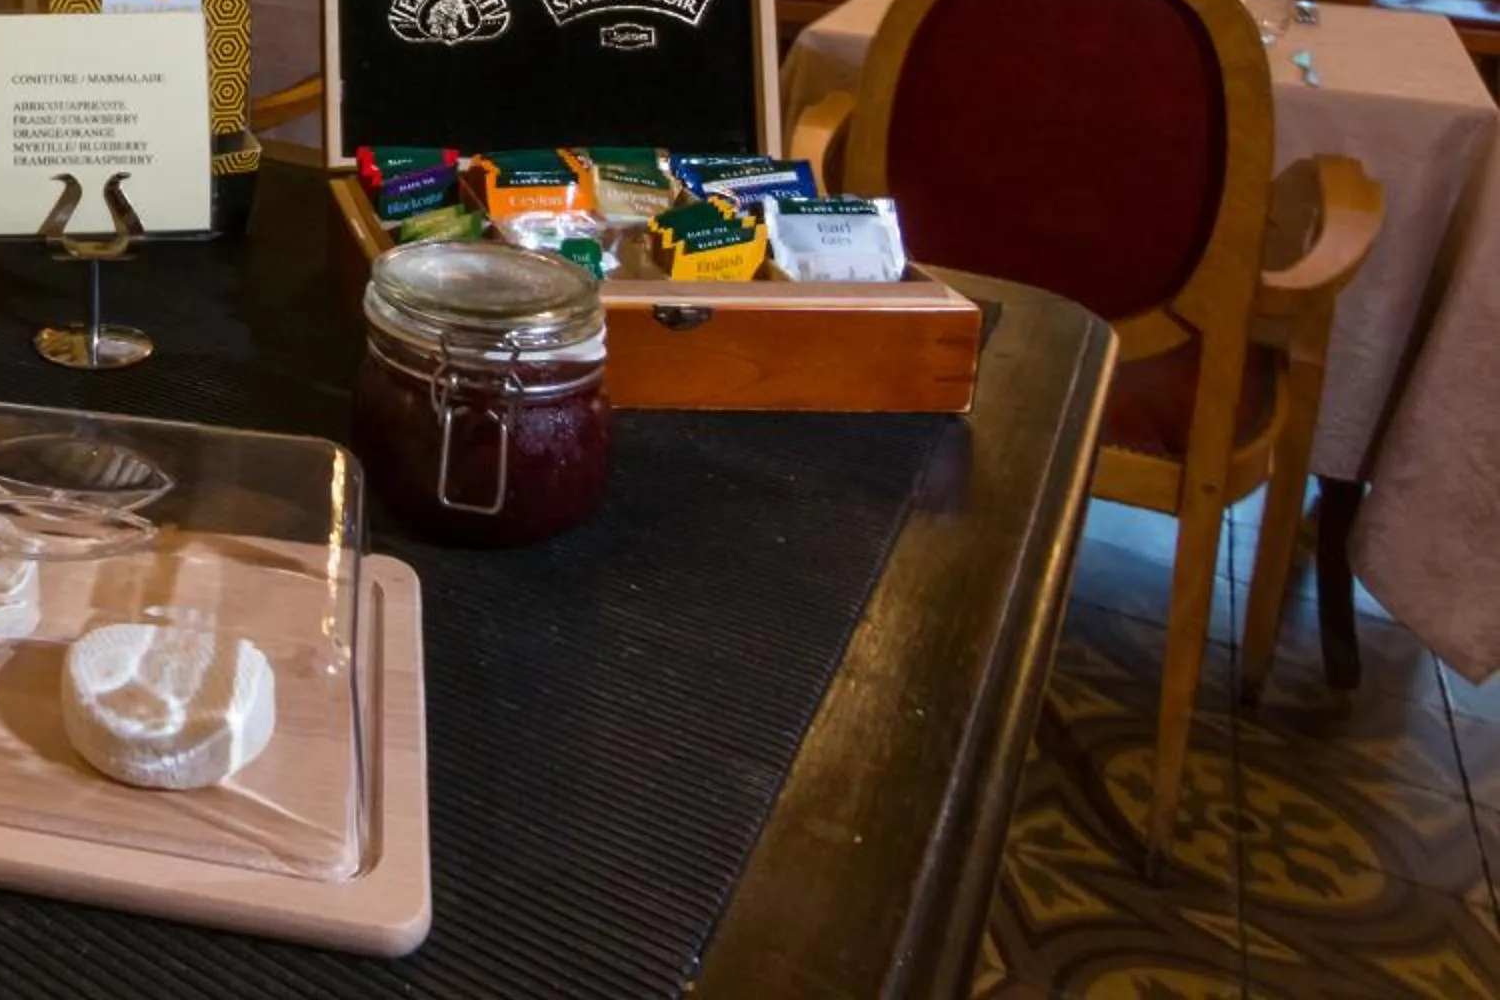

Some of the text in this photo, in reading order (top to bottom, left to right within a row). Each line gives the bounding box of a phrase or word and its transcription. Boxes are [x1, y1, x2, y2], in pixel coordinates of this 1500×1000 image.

[11, 73, 78, 85] CONFITURE
[87, 73, 164, 84] MARMALADE
[60, 113, 139, 125] STRAWBERRY
[79, 140, 148, 152] BLUEBERRY
